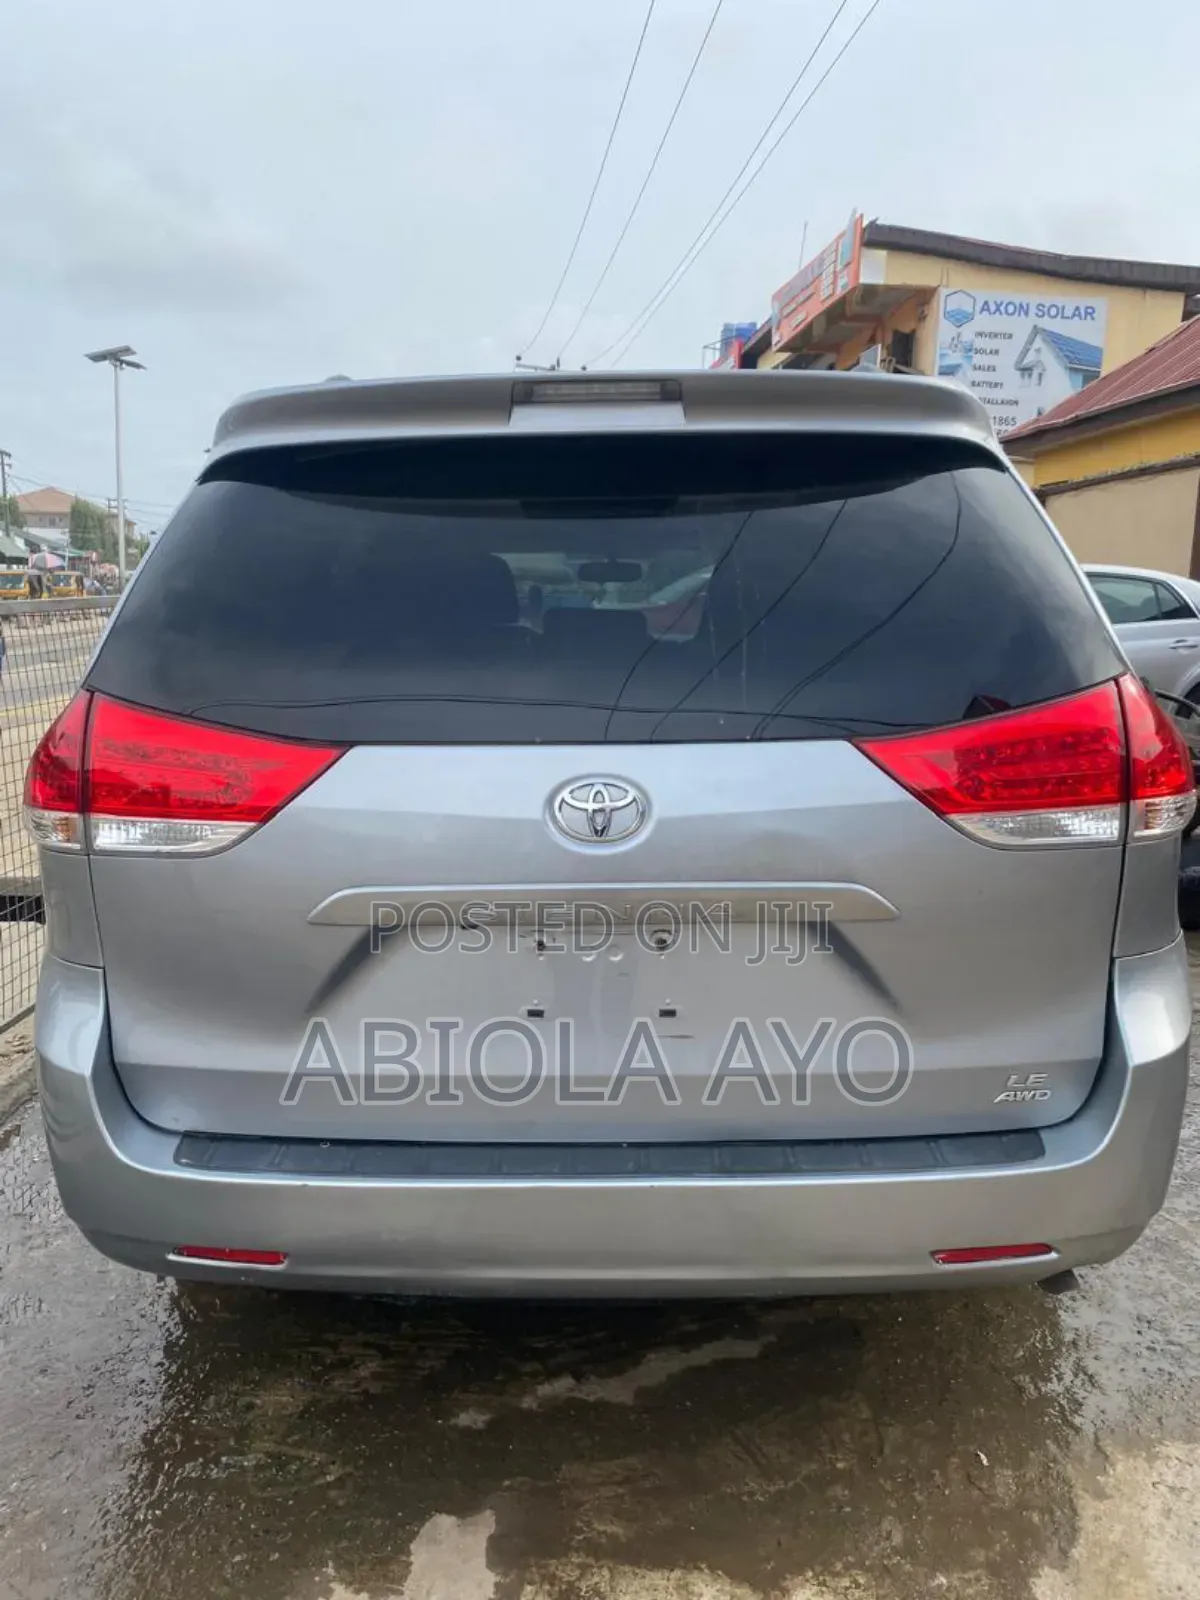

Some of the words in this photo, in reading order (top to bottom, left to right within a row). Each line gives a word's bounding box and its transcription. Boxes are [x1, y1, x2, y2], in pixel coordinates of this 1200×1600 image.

[979, 300, 1030, 318] AXON
[1035, 304, 1096, 321] SOLAR
[974, 331, 1013, 340] INVERTER
[973, 347, 1000, 356] SOLAR
[972, 364, 997, 373] SALES
[970, 380, 1004, 389] BATTERY
[1007, 1073, 1049, 1088] LE
[994, 1090, 1052, 1104] AWD
